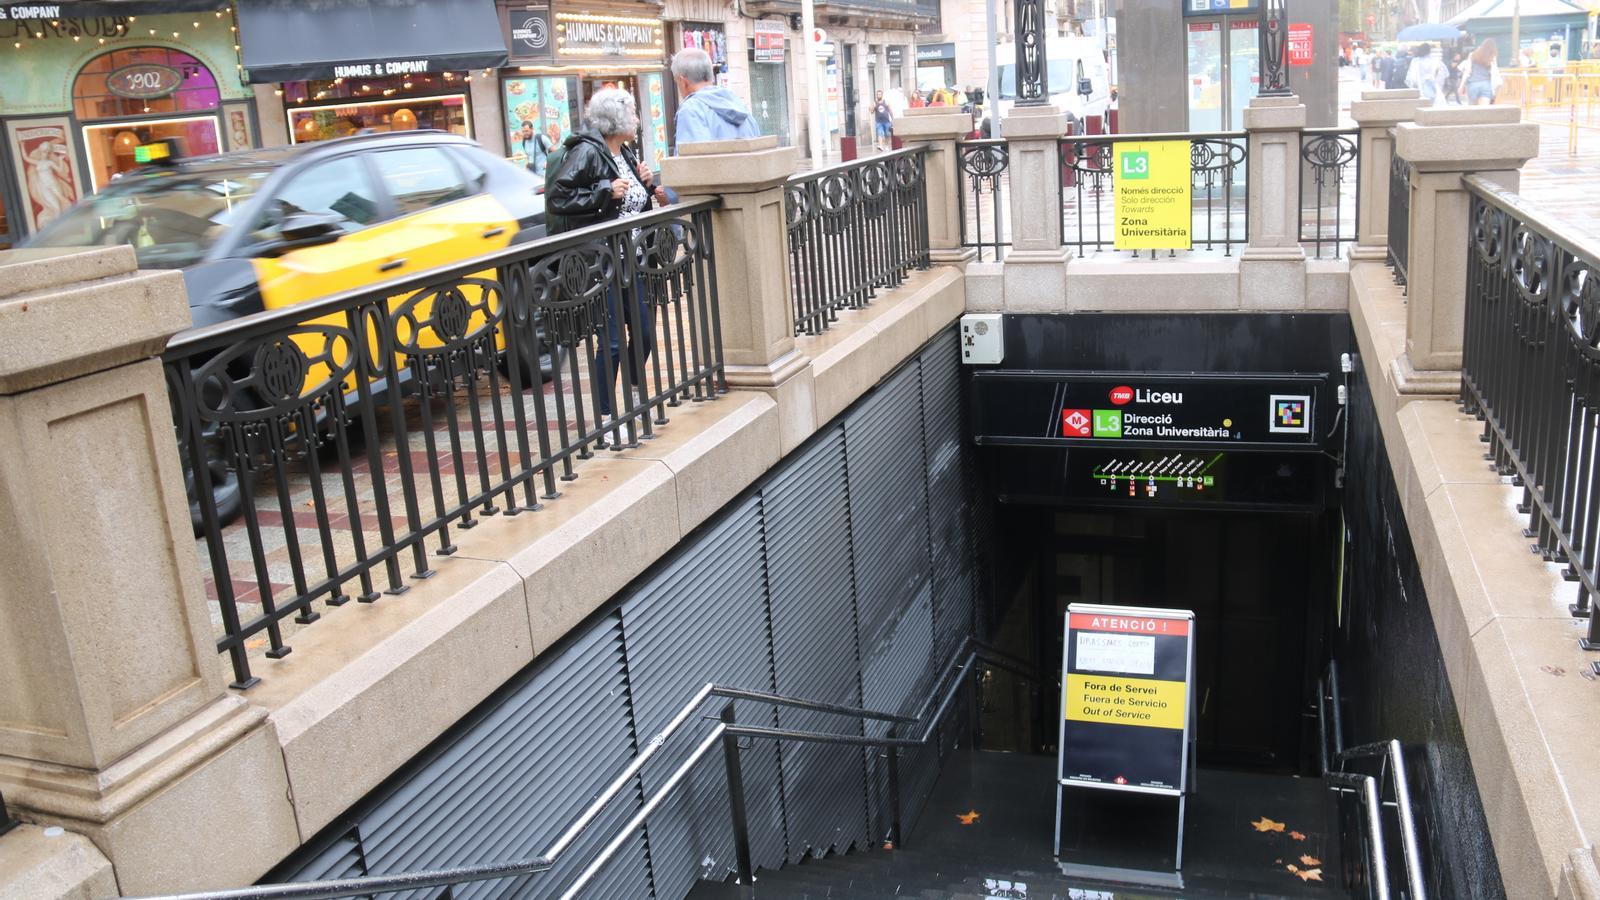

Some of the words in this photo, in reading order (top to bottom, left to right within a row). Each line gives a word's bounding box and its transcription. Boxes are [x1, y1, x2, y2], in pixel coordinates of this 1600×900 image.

[11, 6, 60, 19] COMPANY
[565, 22, 605, 42] HUMMUS
[607, 24, 614, 42] &
[614, 24, 652, 43] COMPANY
[334, 64, 371, 77] HUMMUS
[375, 63, 382, 75] &
[385, 60, 428, 74] COMPANY
[126, 71, 161, 90] 1902
[1123, 156, 1147, 173] L3
[1121, 187, 1149, 195] Només
[1151, 186, 1183, 194] direcció
[1121, 196, 1138, 204] Solo
[1140, 196, 1175, 204] dirección
[1121, 205, 1154, 213] Towards
[1121, 217, 1148, 226] Zona
[1121, 227, 1187, 236] Universitària
[1113, 392, 1131, 400] TMB
[1135, 388, 1183, 404] Liceu
[1071, 416, 1082, 425] M
[1096, 415, 1120, 432] L3
[1124, 413, 1172, 424] Direcció
[1123, 425, 1153, 436] Zona
[1156, 426, 1230, 438] Universitària
[1091, 617, 1156, 631] ATENCIÓ
[1161, 621, 1167, 632] !
[1084, 681, 1107, 691] Fora
[1109, 683, 1122, 692] de
[1125, 685, 1158, 695] Servei
[1083, 694, 1111, 704] Fuera
[1113, 697, 1126, 705] de
[1128, 697, 1168, 709] Servicio
[1083, 706, 1100, 715] Out
[1102, 708, 1113, 717] of
[1115, 709, 1151, 720] Service
